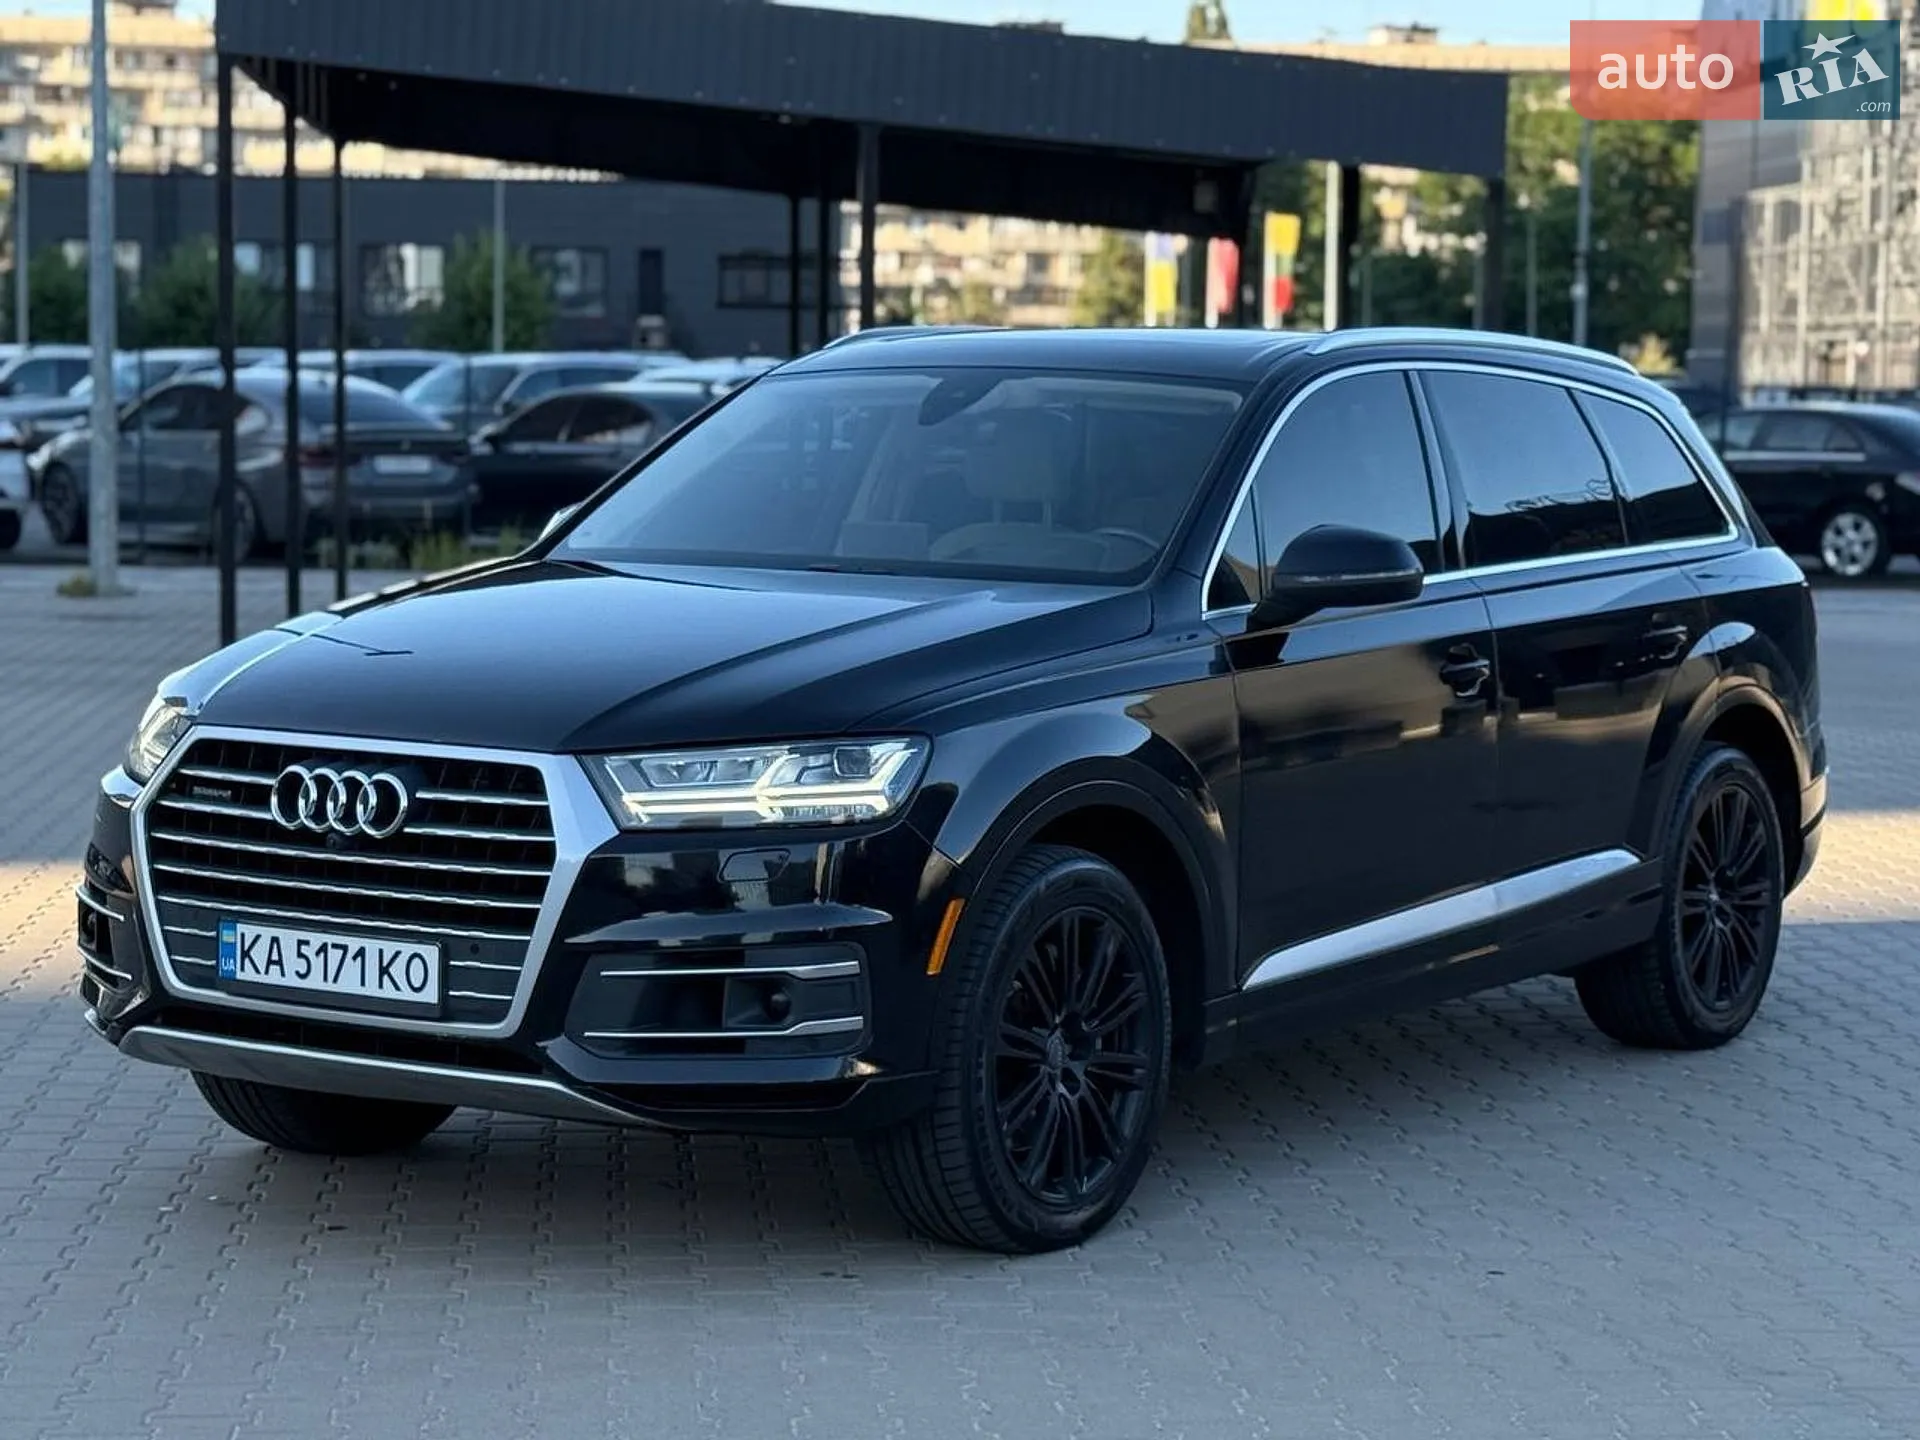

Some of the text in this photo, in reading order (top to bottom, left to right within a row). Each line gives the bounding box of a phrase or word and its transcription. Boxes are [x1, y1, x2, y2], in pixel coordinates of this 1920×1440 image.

[220, 956, 235, 972] UA
[240, 932, 428, 993] KA 5171 KO
